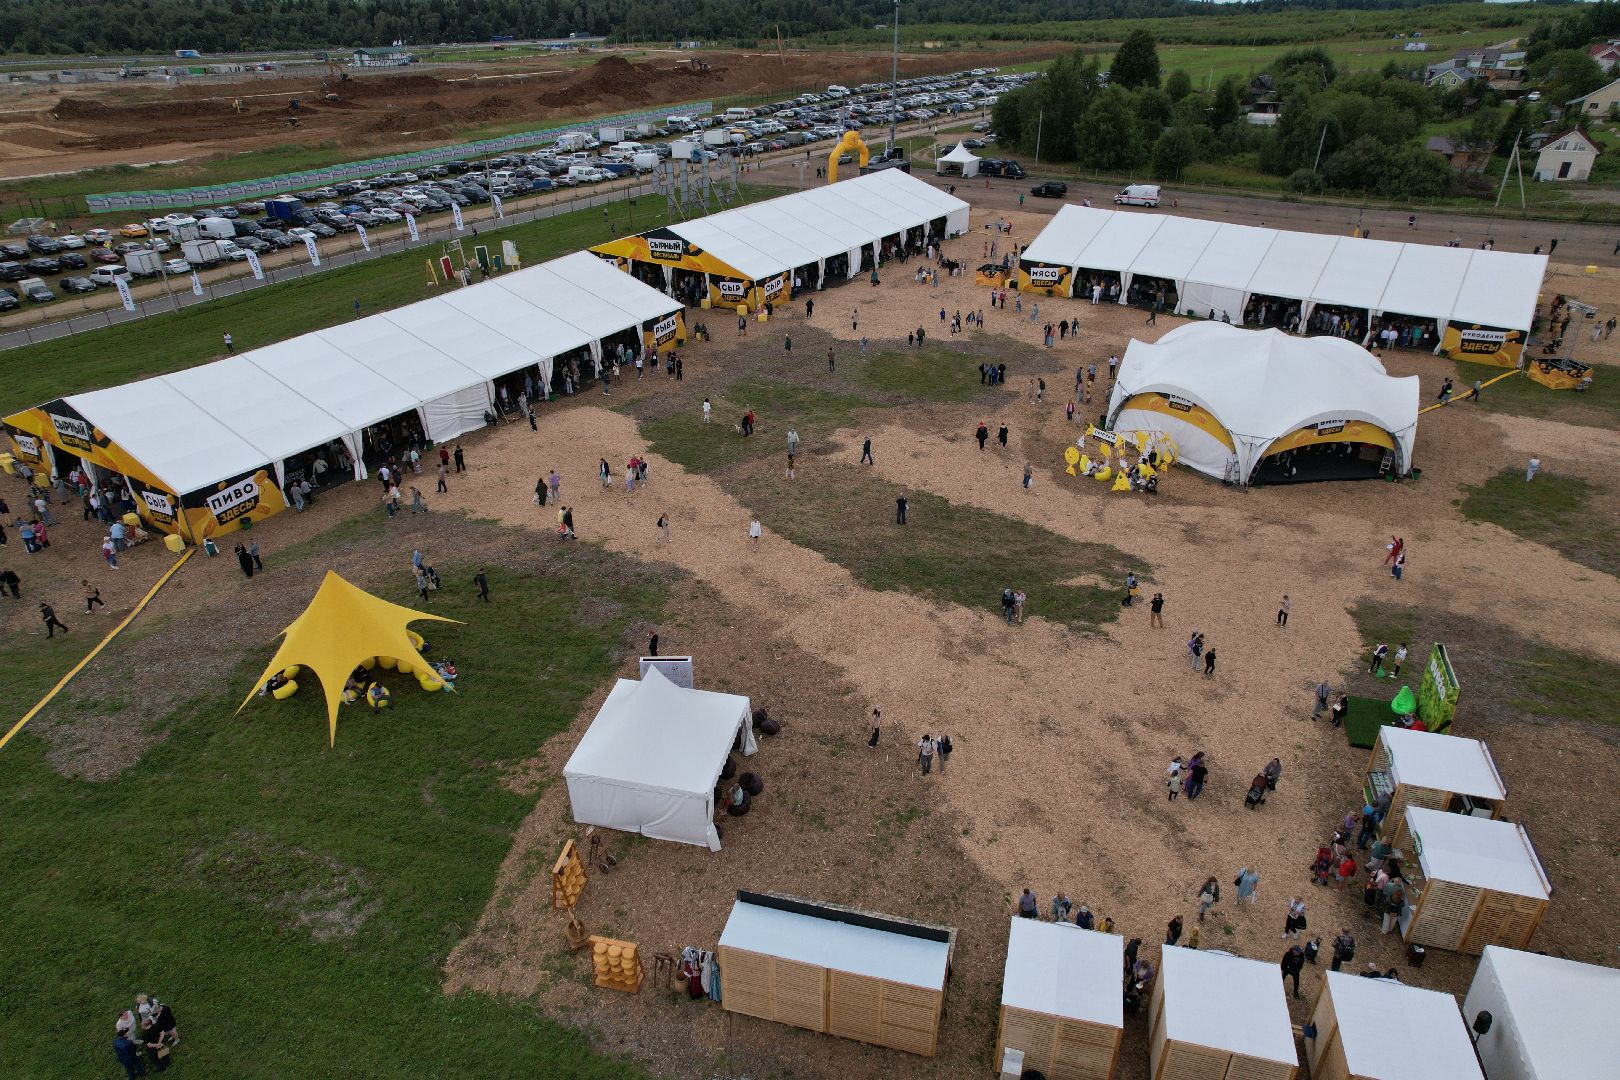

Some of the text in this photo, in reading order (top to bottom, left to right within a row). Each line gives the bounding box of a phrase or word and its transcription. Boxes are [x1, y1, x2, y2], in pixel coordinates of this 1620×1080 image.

[650, 241, 681, 251] СЫРНЫЙ
[1032, 270, 1057, 278] МЯСО
[721, 283, 741, 292] СЫР
[765, 279, 781, 293] СЫР
[655, 318, 676, 335] РЫБА
[1461, 342, 1500, 352] ЗДЕСЬ!
[54, 419, 88, 436] СЫРНЫЙ
[145, 494, 167, 509] СЫР
[211, 483, 254, 510] ПИВО
[220, 498, 256, 523] ЗДЕСЬ!
